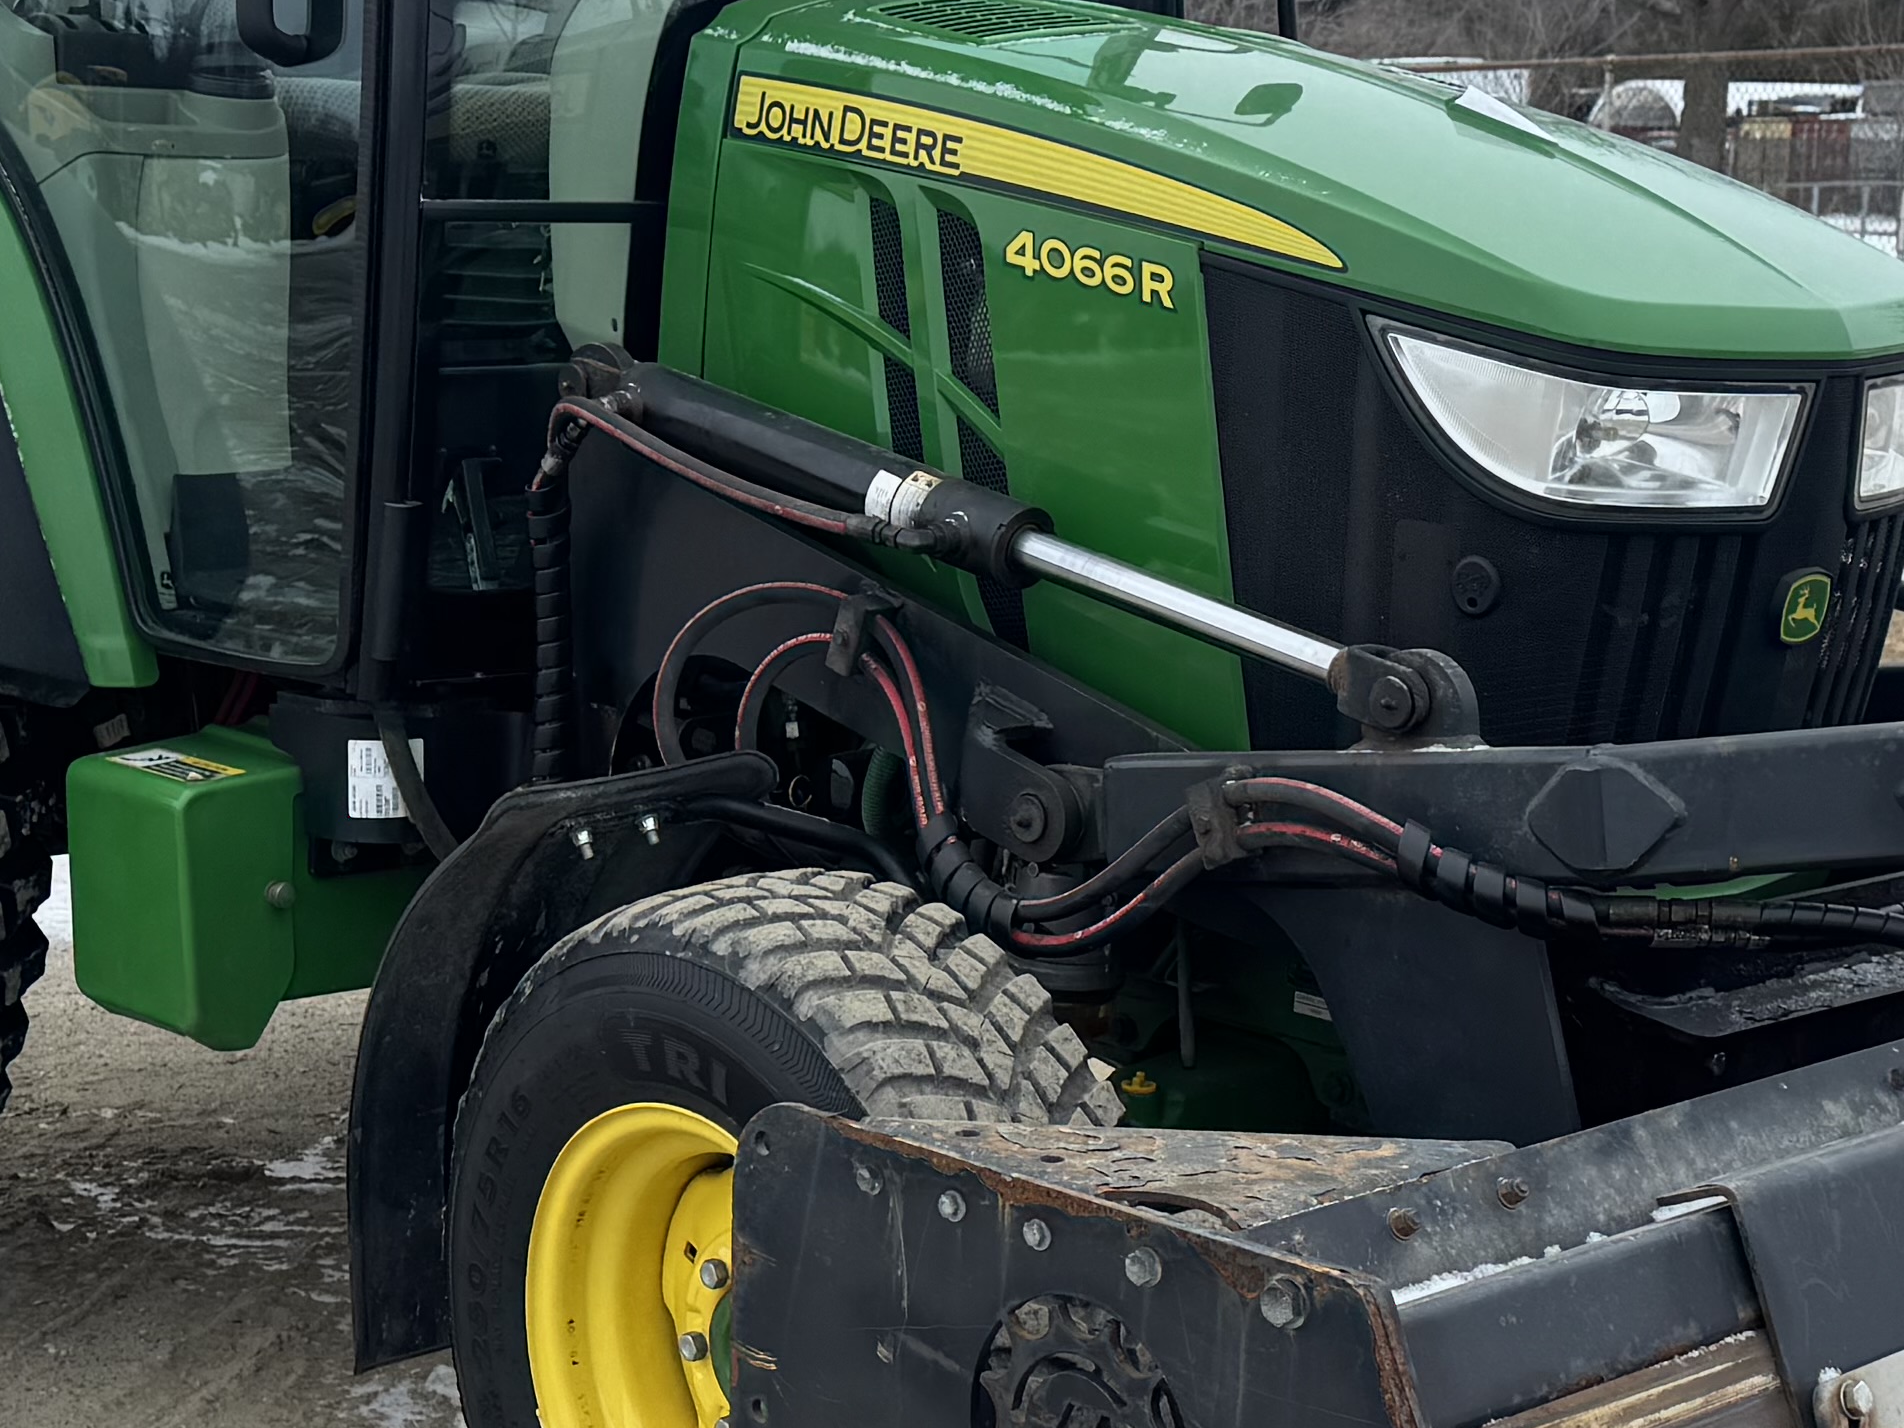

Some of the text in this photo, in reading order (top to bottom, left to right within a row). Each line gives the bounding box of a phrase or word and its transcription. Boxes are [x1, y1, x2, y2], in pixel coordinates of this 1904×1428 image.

[746, 91, 963, 171] JOHN DEERE
[616, 1027, 732, 1109] TRI
